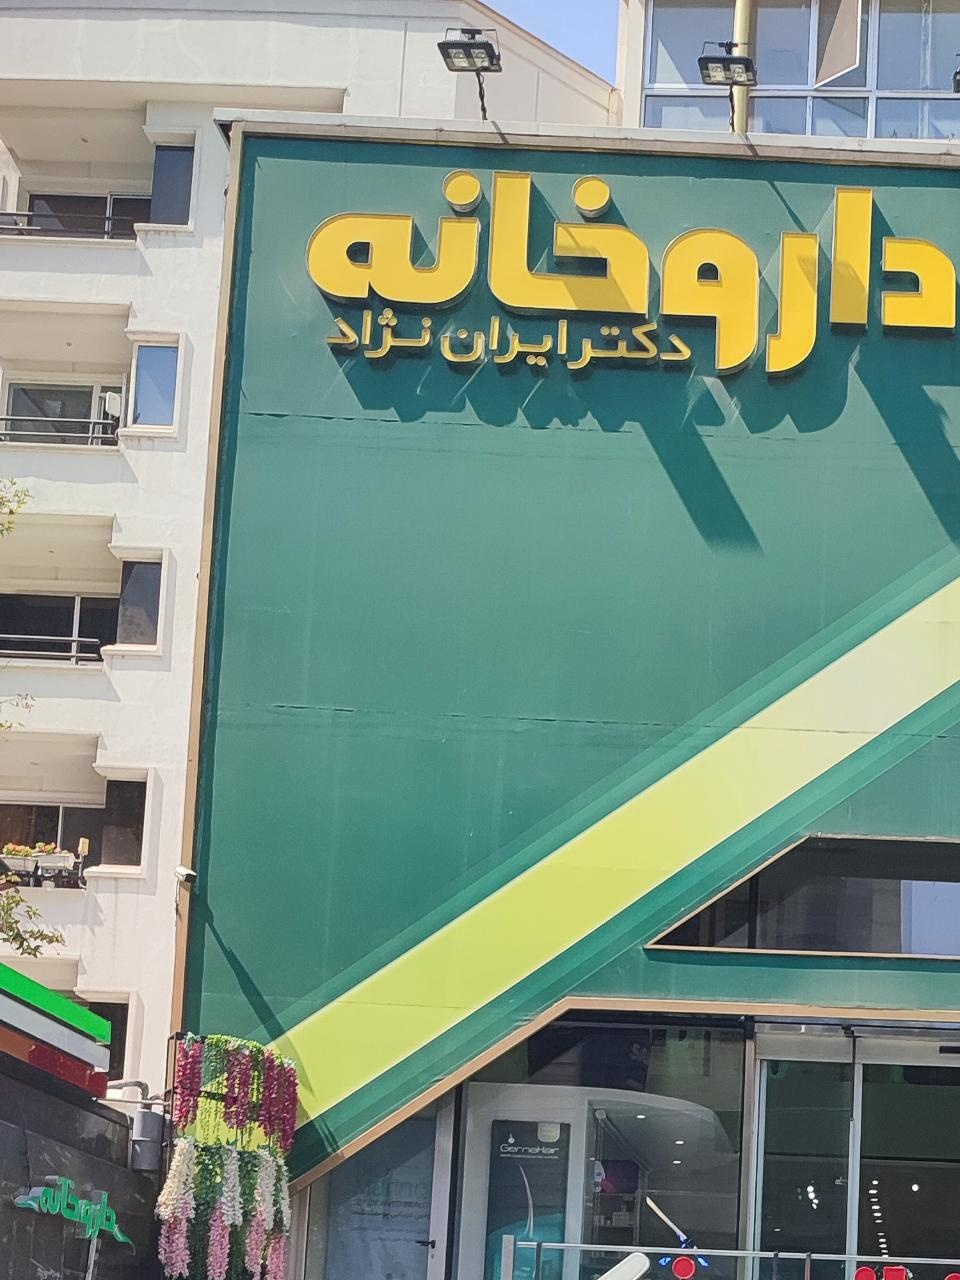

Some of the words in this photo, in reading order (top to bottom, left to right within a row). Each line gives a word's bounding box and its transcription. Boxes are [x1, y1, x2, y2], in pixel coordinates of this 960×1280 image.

[305, 170, 956, 376] داروخانه
[326, 307, 433, 358] نژاد
[440, 315, 568, 366] ایران
[566, 321, 692, 370] دکتر
